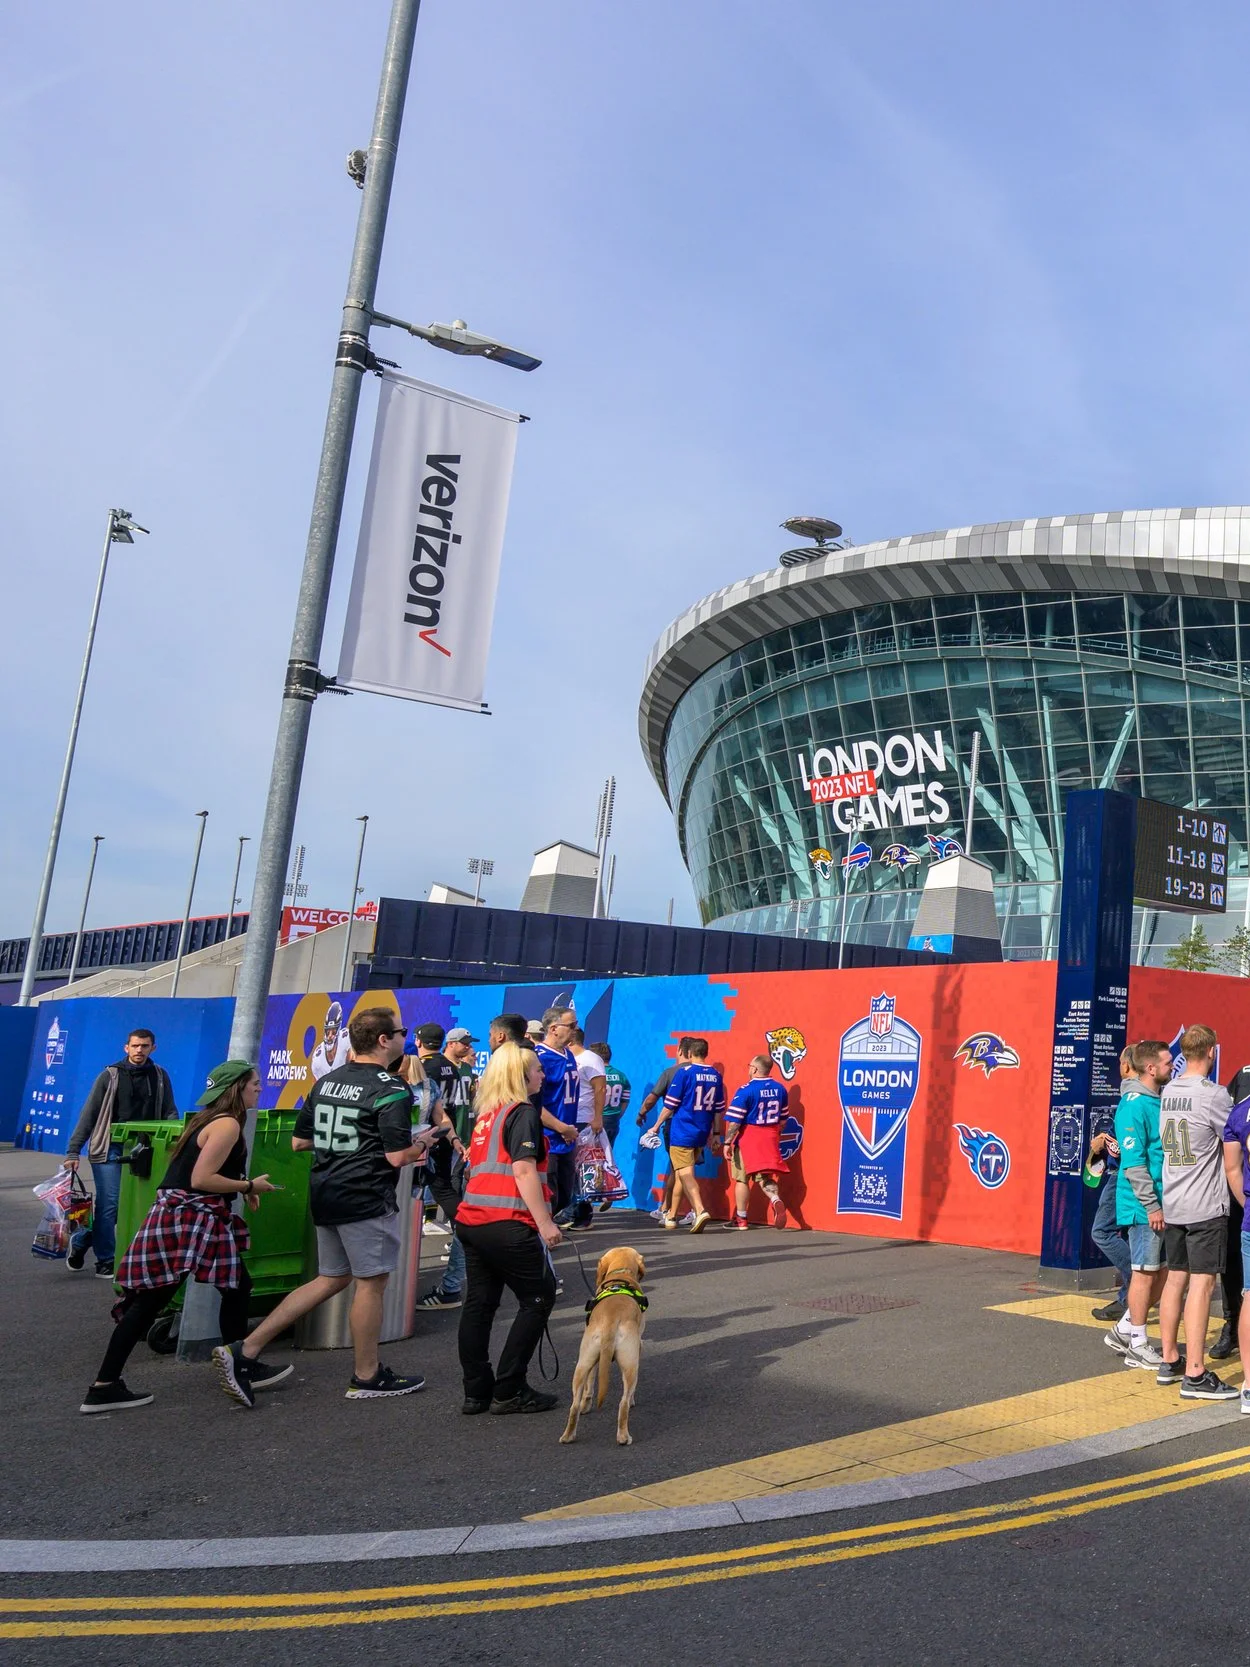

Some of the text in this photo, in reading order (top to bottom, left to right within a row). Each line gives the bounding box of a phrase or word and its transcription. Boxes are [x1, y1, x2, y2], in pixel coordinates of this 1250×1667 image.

[403, 454, 462, 628] verizon
[798, 730, 947, 791] LONDON
[812, 777, 875, 800] 2023 NFL
[832, 781, 950, 833] GAMES
[1177, 815, 1208, 838] 1-10
[1167, 845, 1206, 869] 11-18
[1165, 876, 1205, 900] 19-23
[872, 1013, 890, 1034] NFL
[269, 1050, 293, 1064] MARK
[871, 1044, 887, 1052] 2023
[267, 1065, 307, 1080] ANDREWS
[440, 1066, 453, 1076] JACK
[696, 1073, 717, 1083] WATKINS
[843, 1069, 913, 1088] LONDON
[320, 1081, 364, 1101] WILLIAMS
[563, 1071, 579, 1104] 17
[693, 1085, 717, 1111] 14
[760, 1088, 779, 1098] KELLY
[861, 1091, 890, 1100] GAMES
[1126, 1092, 1141, 1102] 17
[756, 1100, 780, 1124] 12
[1161, 1098, 1192, 1111] KAMARA
[314, 1104, 360, 1152] 95
[1162, 1118, 1197, 1167] 41
[853, 1172, 888, 1199] USA
[853, 1198, 887, 1206] VisitTheUSA.co.uk
